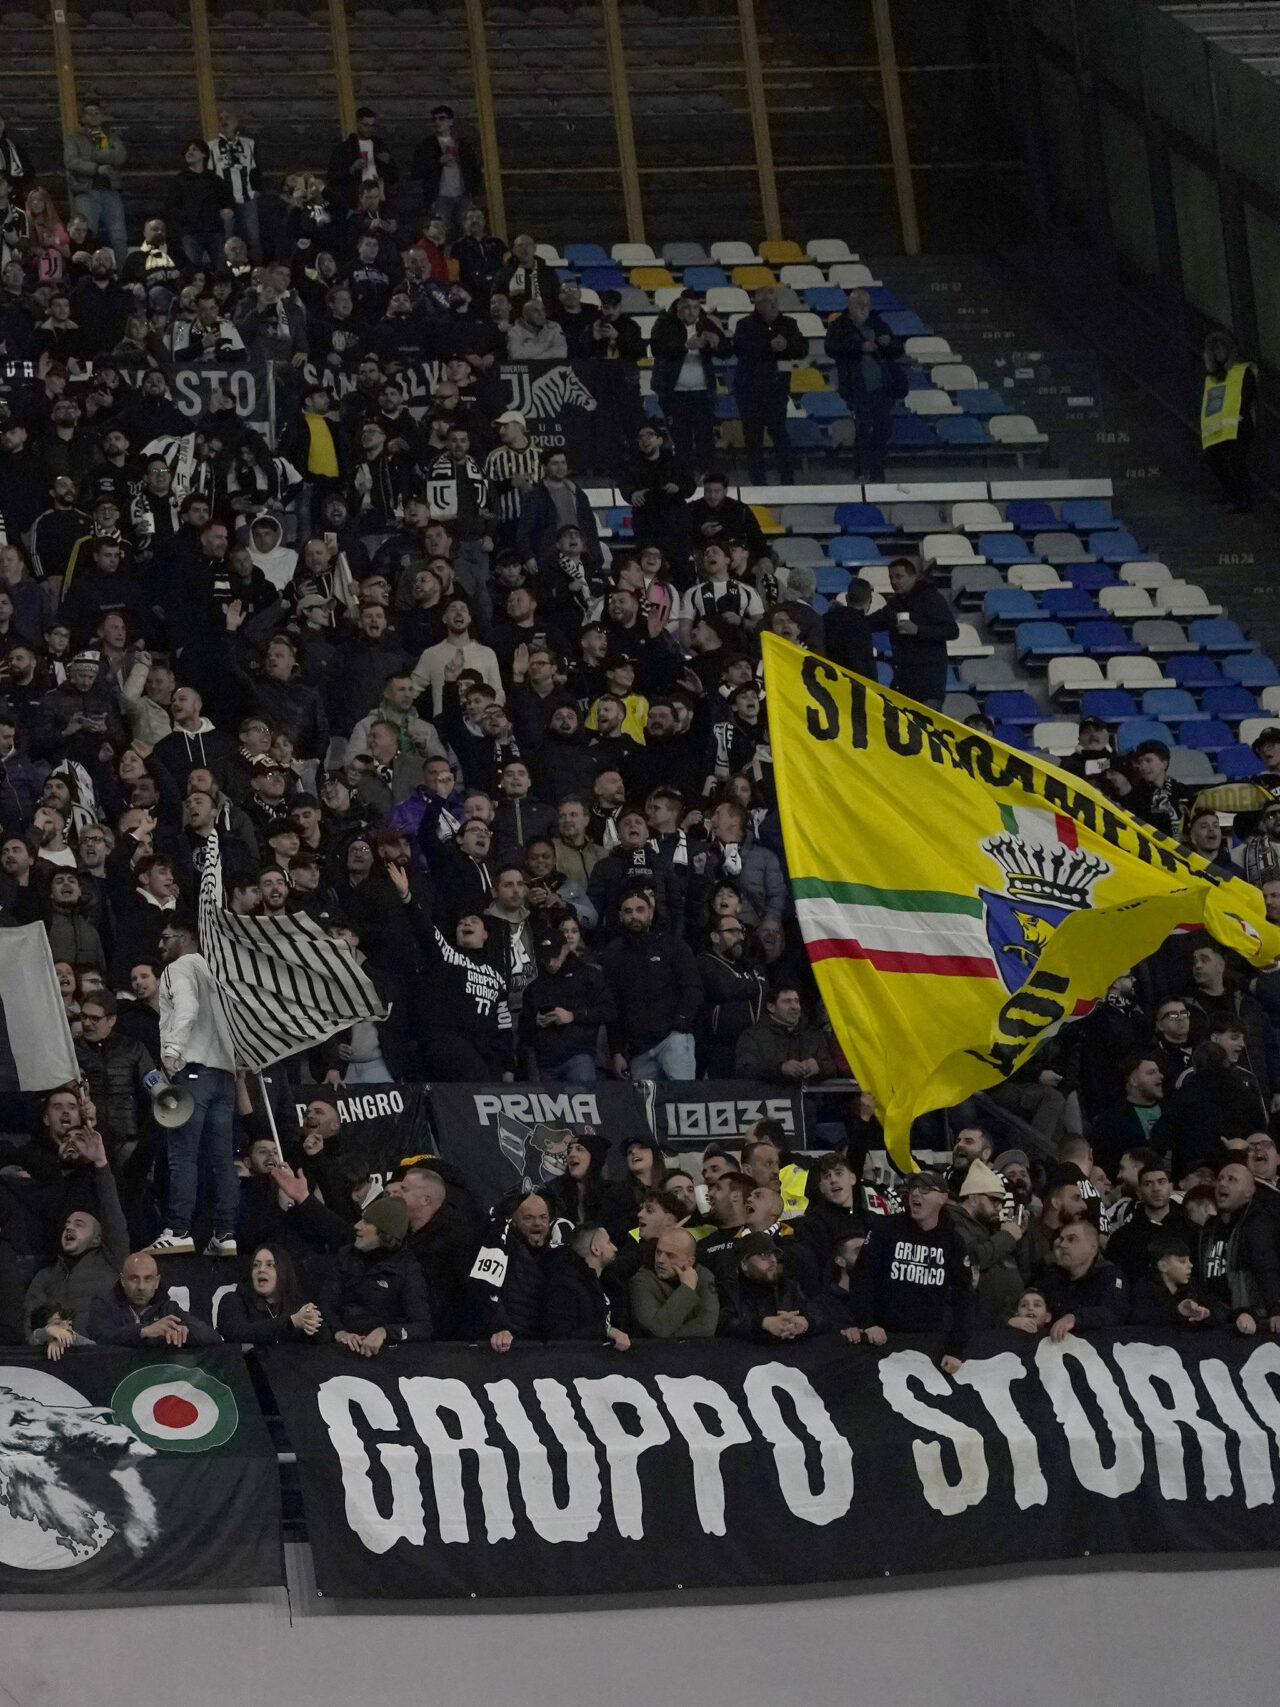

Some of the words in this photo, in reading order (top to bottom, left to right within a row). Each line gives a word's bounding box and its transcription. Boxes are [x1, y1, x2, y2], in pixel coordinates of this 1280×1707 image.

[336, 1090, 405, 1125] ANGRO
[473, 1093, 602, 1126] PRIMA
[894, 1241, 945, 1265] GRUPPO
[890, 1262, 945, 1286] STORICO
[317, 1361, 855, 1555] GRUPPO
